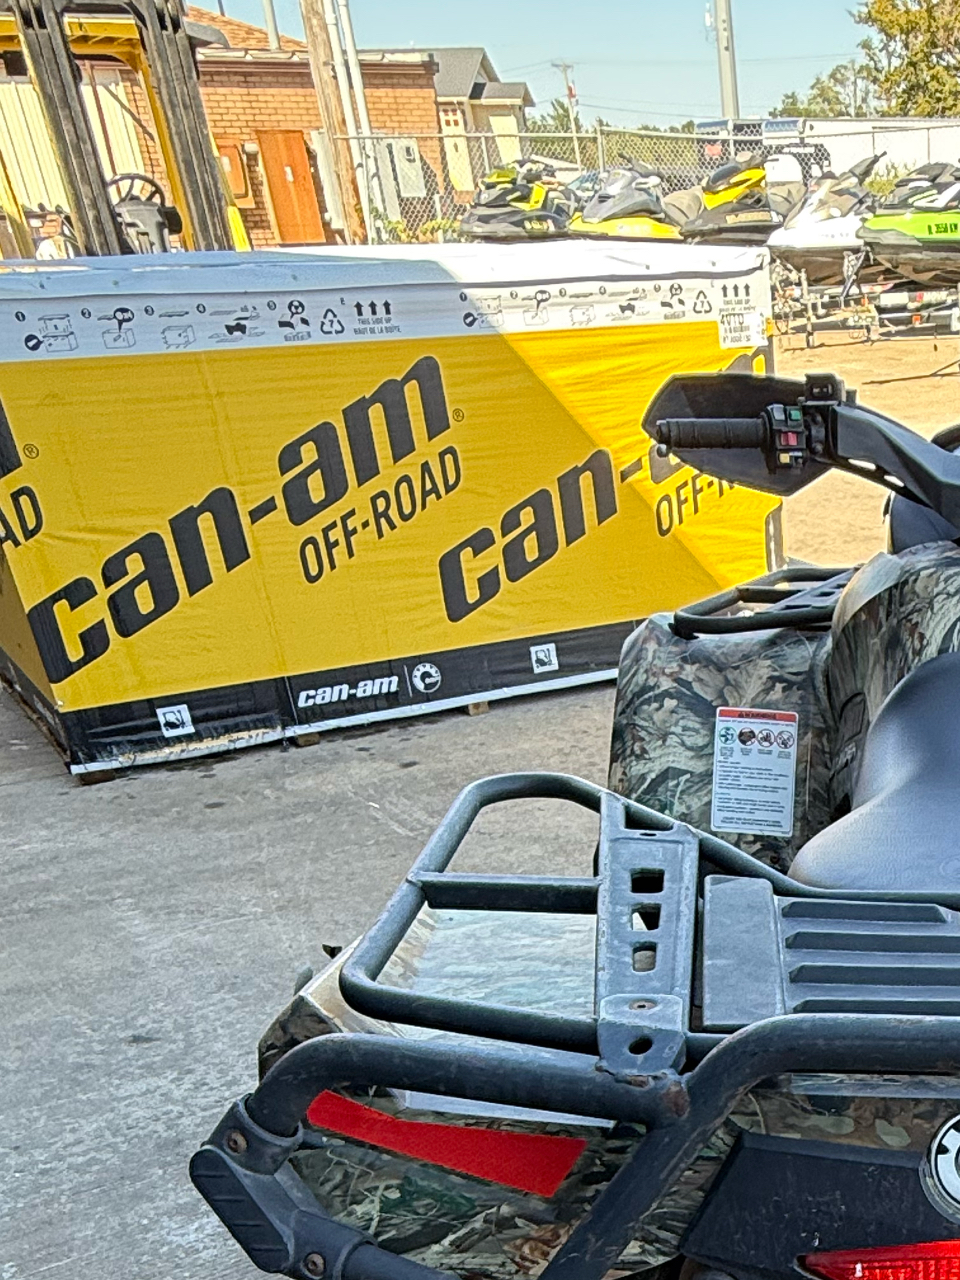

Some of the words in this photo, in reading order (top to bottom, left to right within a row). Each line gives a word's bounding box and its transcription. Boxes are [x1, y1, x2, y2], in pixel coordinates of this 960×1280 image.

[27, 355, 451, 684] can-am
[299, 445, 461, 584] OFF-ROAD
[655, 472, 735, 537] OFF-
[297, 675, 399, 708] can-am
